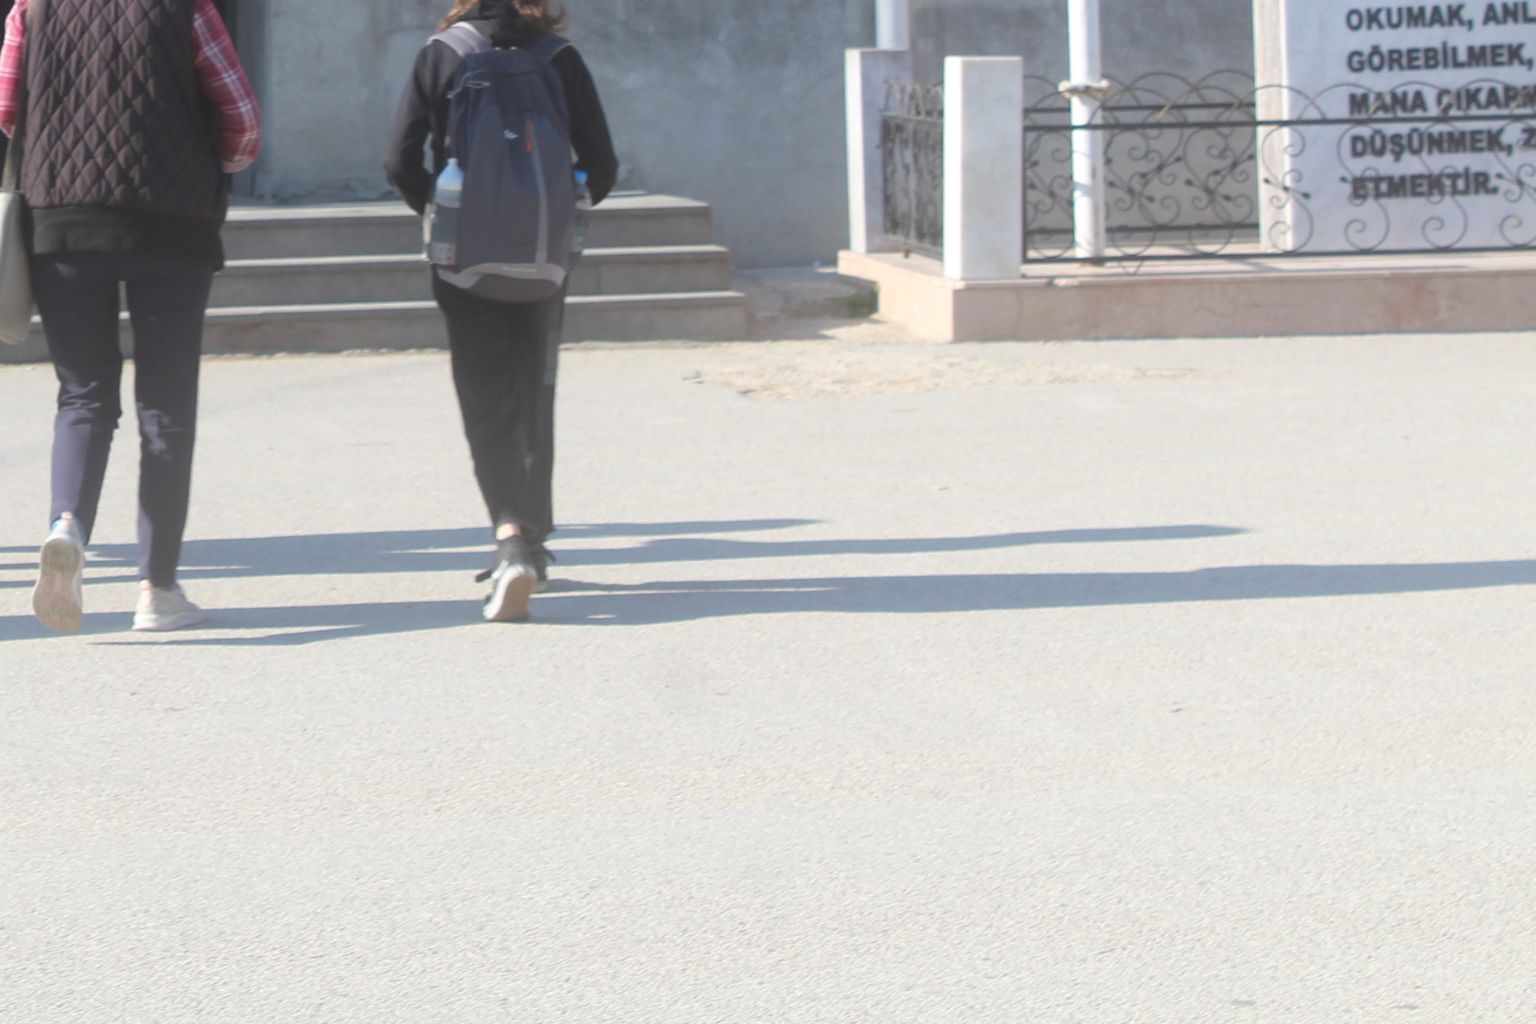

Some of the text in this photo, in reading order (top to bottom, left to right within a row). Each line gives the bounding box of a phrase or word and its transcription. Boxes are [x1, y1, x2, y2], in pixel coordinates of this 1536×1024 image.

[1346, 1, 1536, 32] OKUMAK, ANL
[1347, 41, 1535, 74] GÖREBİLMEK,
[1348, 90, 1428, 116] MANA
[1350, 128, 1514, 163] DÜŞÜNMEK,
[1351, 167, 1500, 200] ETMEKTİR.
